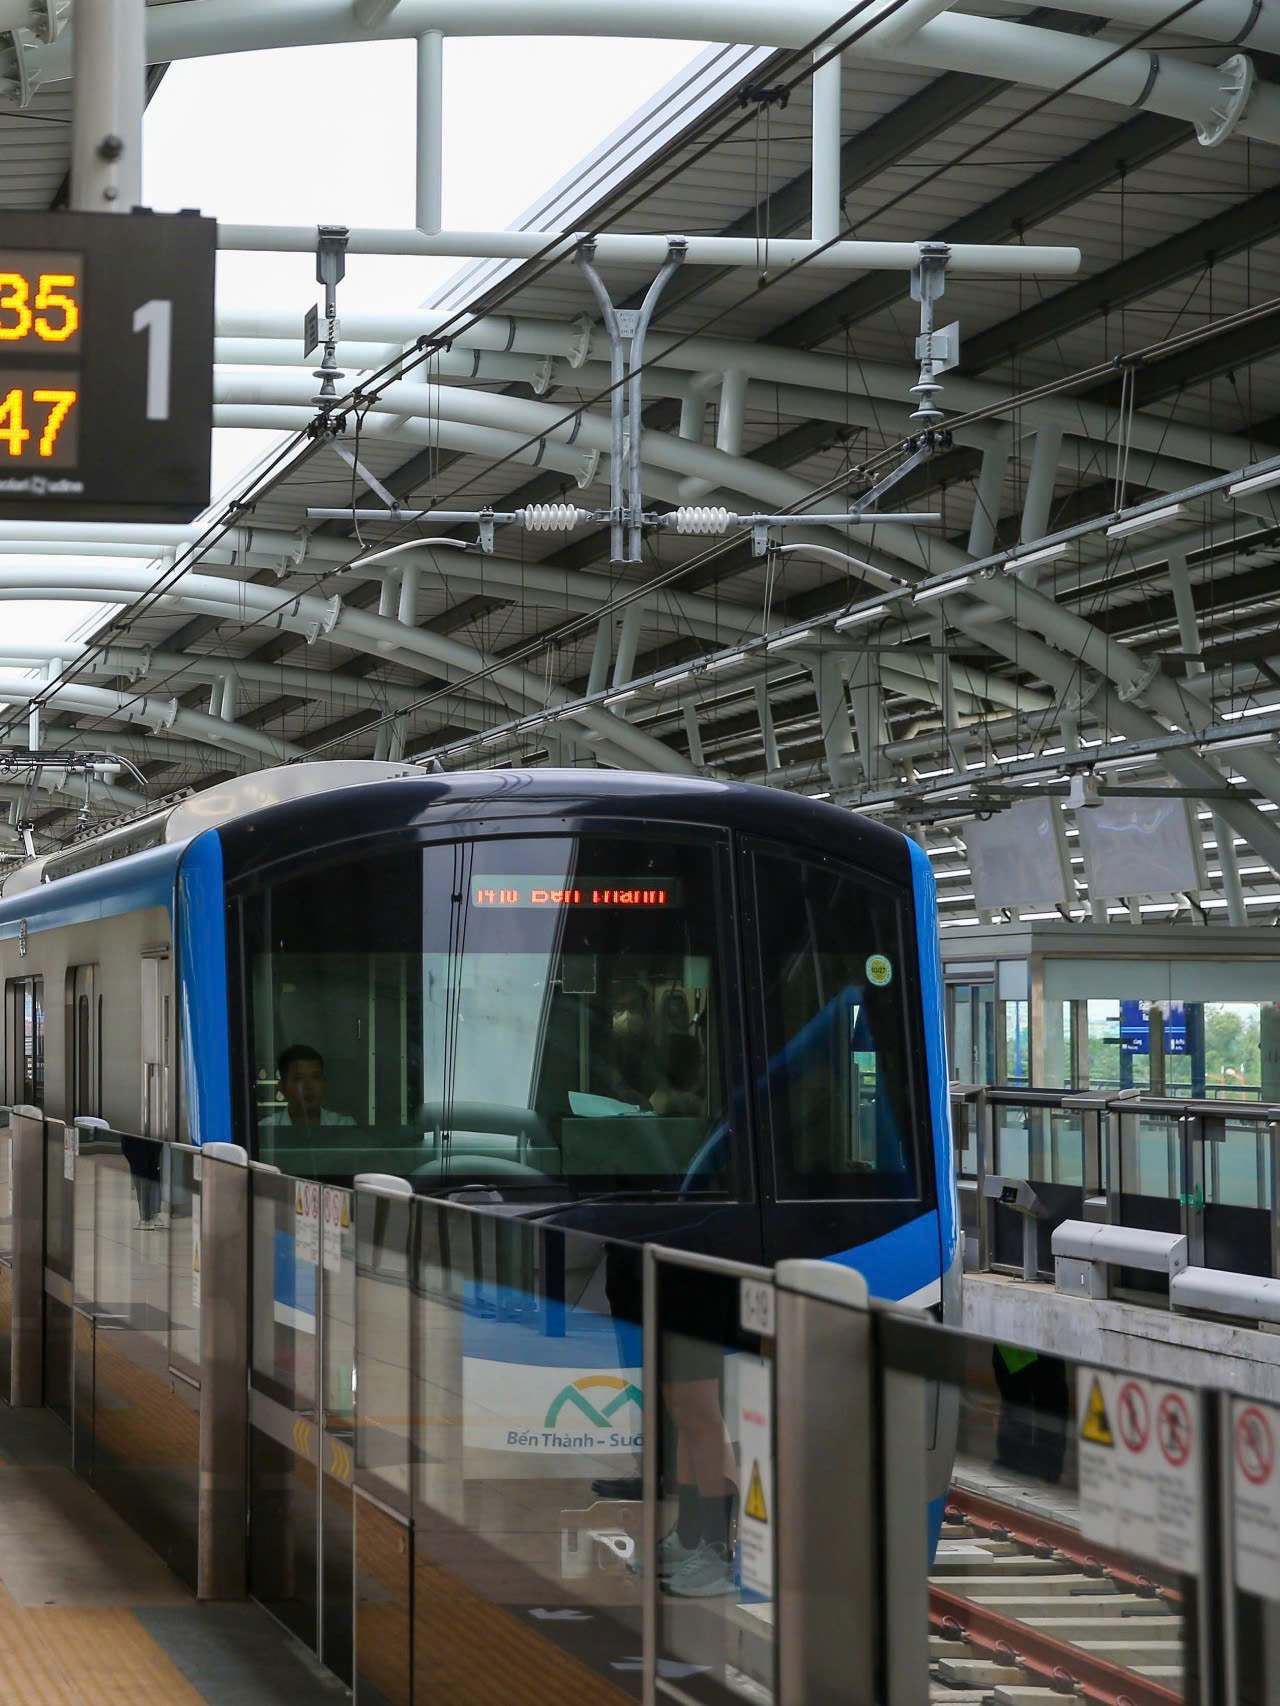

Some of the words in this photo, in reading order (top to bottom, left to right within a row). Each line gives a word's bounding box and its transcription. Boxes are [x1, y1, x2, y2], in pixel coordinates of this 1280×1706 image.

[132, 299, 173, 421] 1
[507, 1430, 538, 1447] Bến
[541, 1432, 594, 1448] Thành
